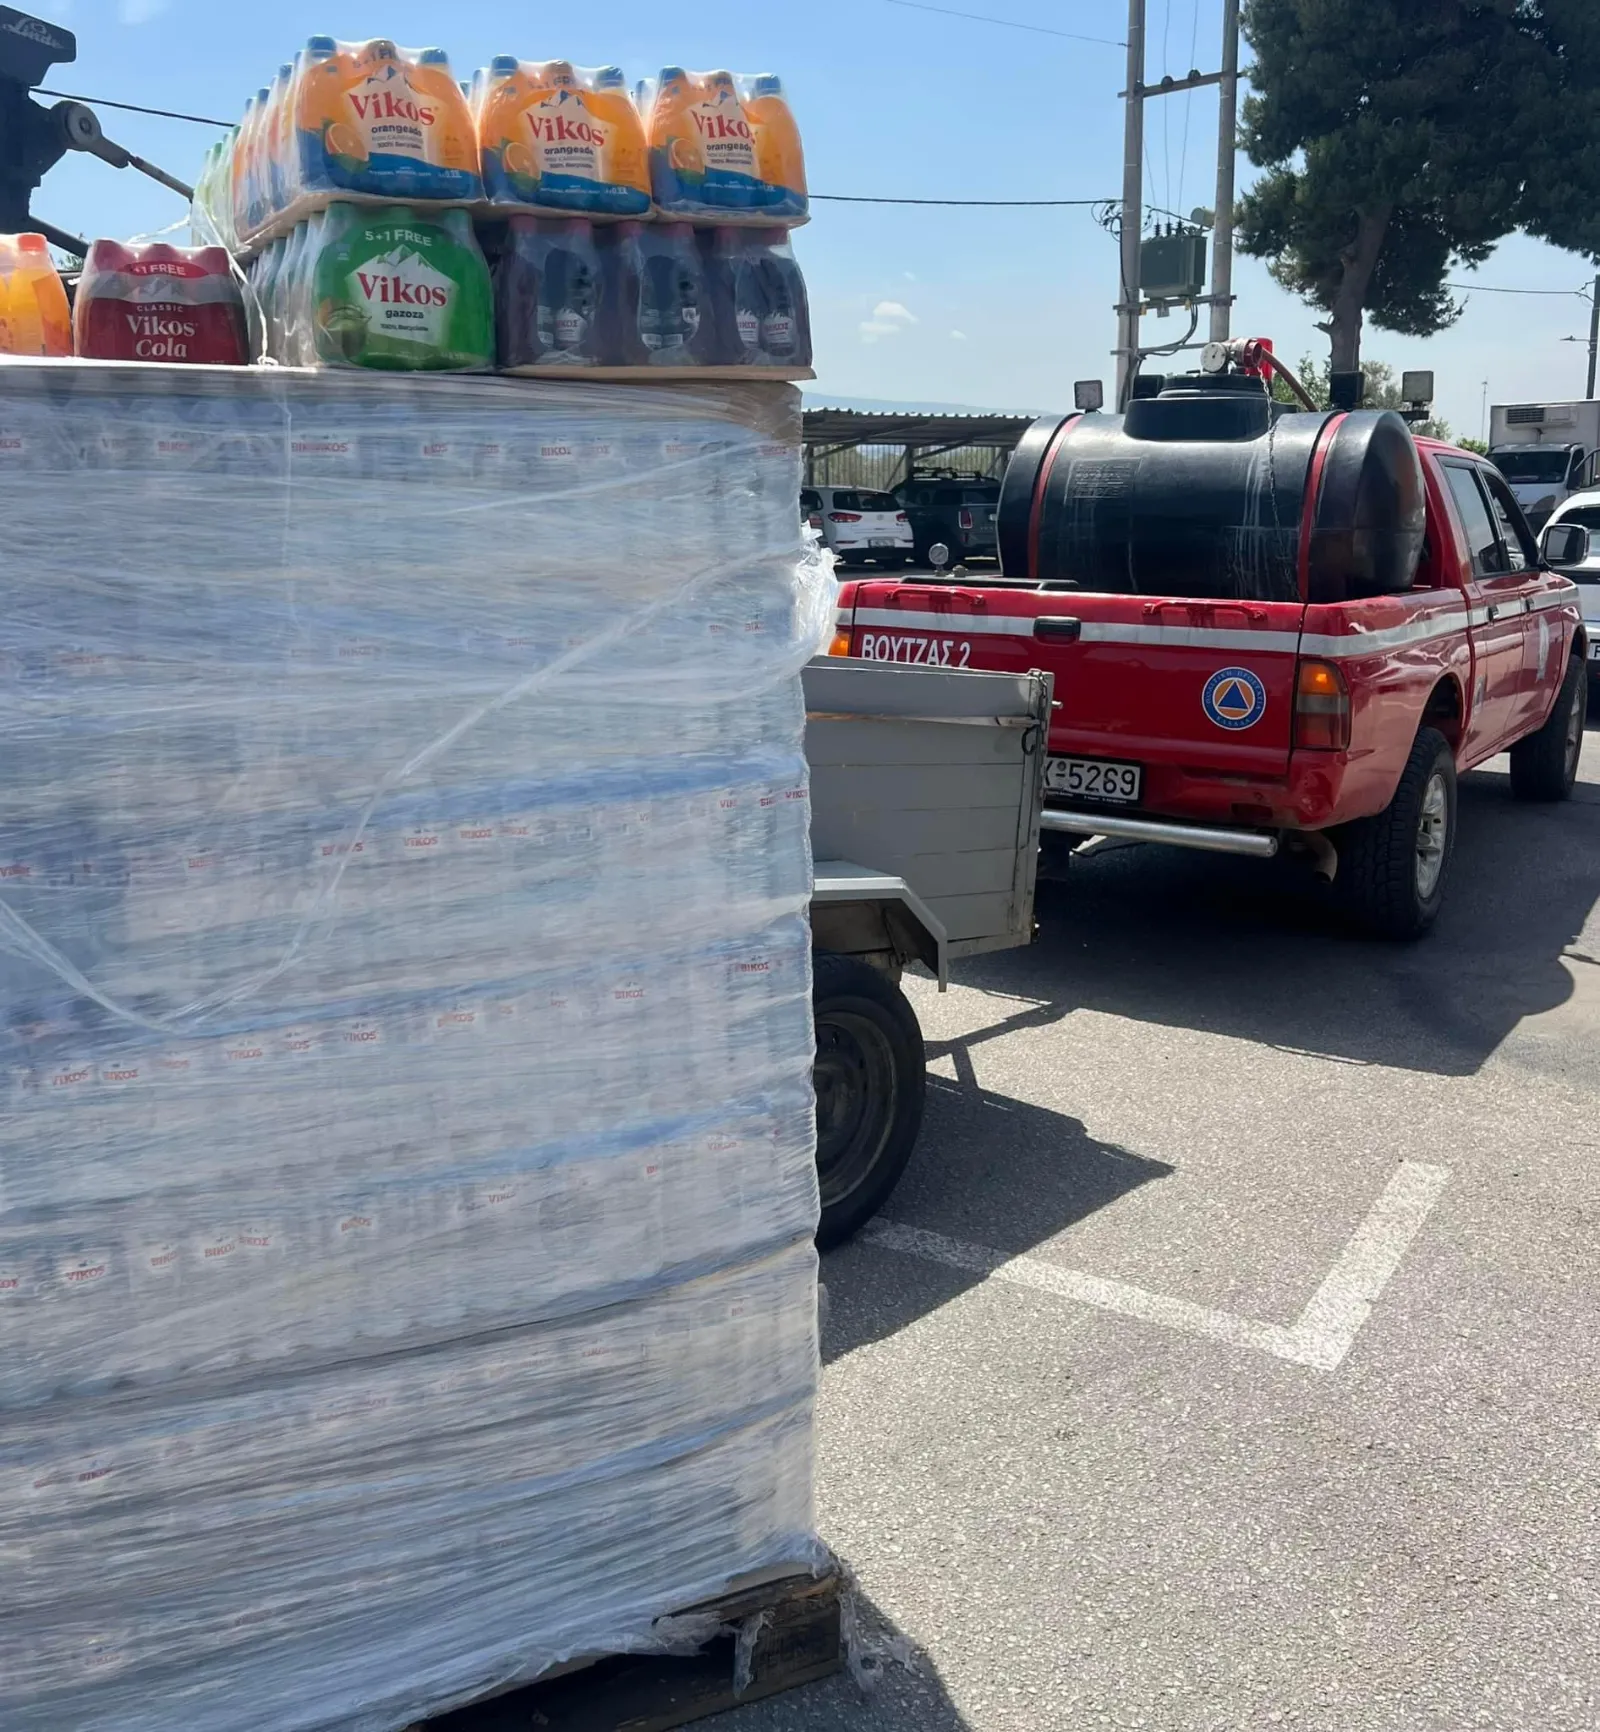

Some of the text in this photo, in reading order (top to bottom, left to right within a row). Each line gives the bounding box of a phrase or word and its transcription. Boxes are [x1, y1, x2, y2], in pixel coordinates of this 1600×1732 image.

[348, 90, 435, 126] Vikos
[526, 115, 605, 147] Vikos
[365, 229, 433, 247] 5+1 FREE
[149, 264, 187, 276] FREE
[356, 271, 447, 307] Vikos
[136, 304, 184, 313] CLASSIC
[385, 309, 425, 319] gazoza
[126, 314, 196, 337] Vikos
[136, 337, 188, 358] Cola
[959, 641, 971, 668] 2
